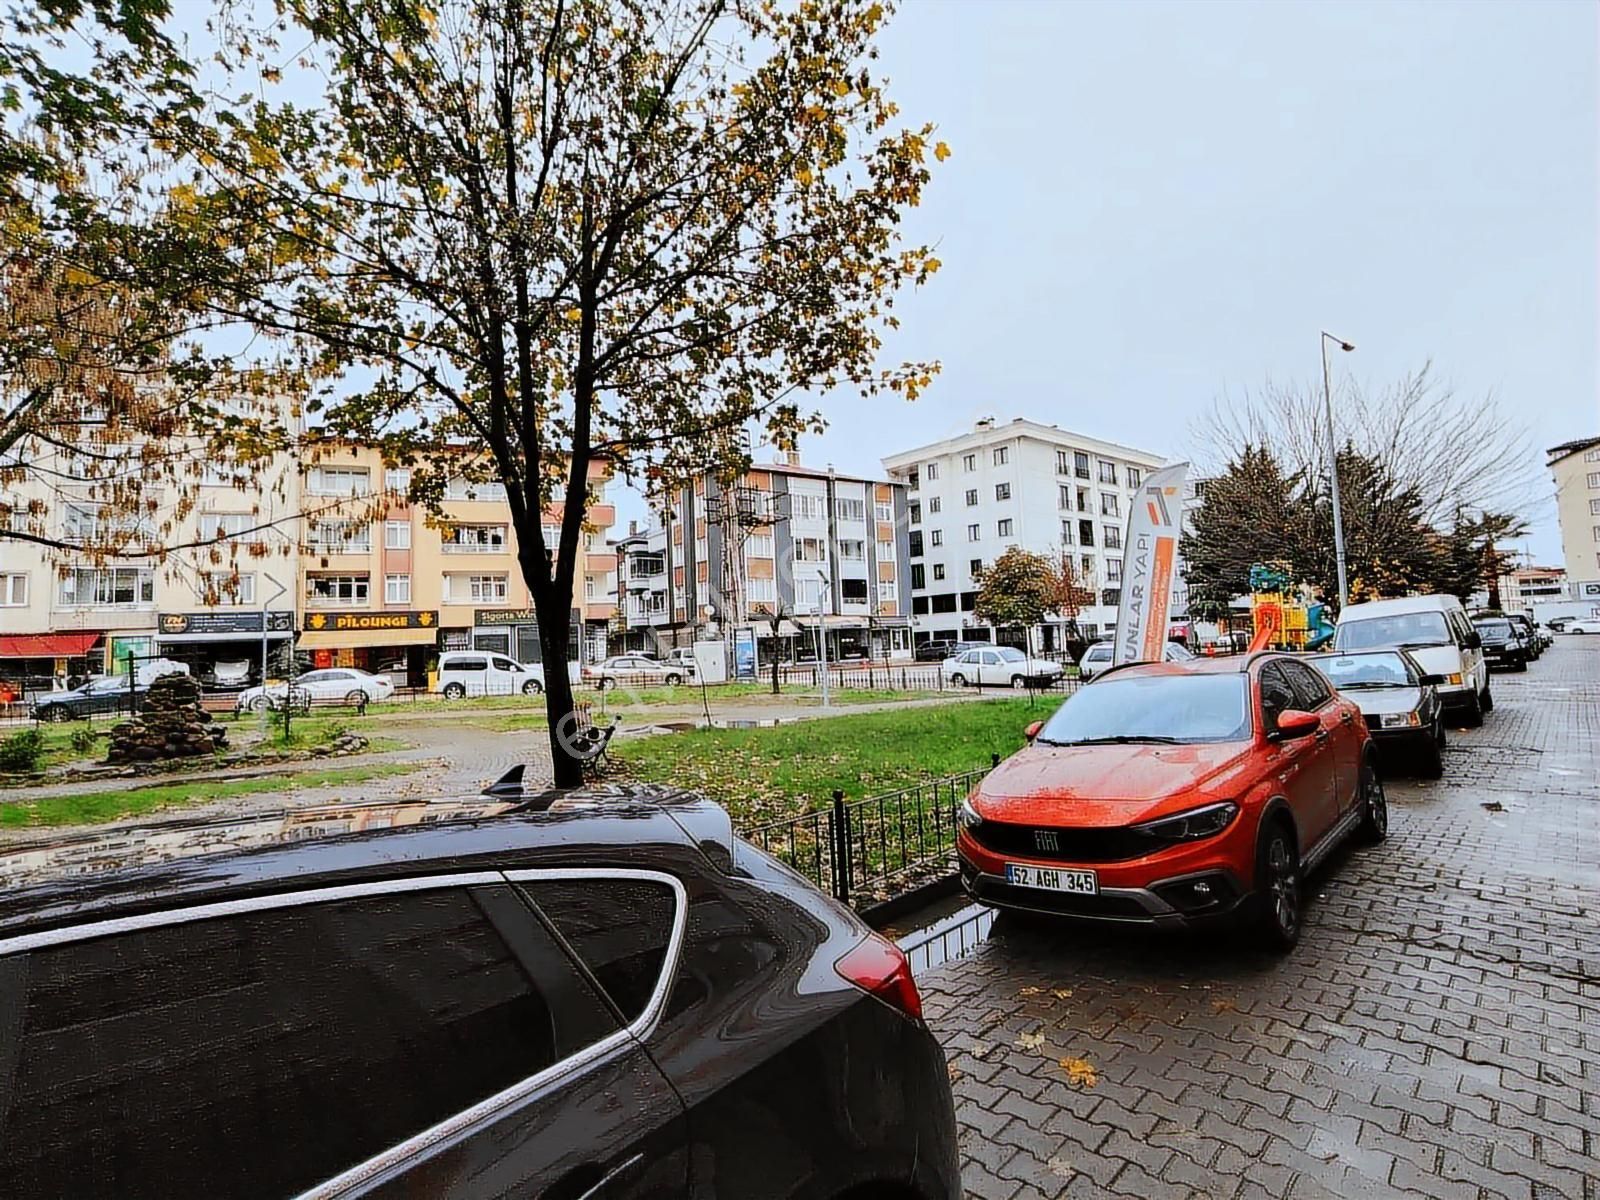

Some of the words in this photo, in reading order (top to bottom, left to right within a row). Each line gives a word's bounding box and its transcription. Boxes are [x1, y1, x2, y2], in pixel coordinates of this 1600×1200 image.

[1125, 585, 1143, 663] UNLAR
[1135, 533, 1150, 579] YAPI
[481, 611, 514, 621] Sigorta
[1035, 831, 1058, 851] FIAT
[1014, 867, 1029, 885] 52
[1036, 870, 1060, 889] AGH
[1067, 873, 1093, 891] 345
